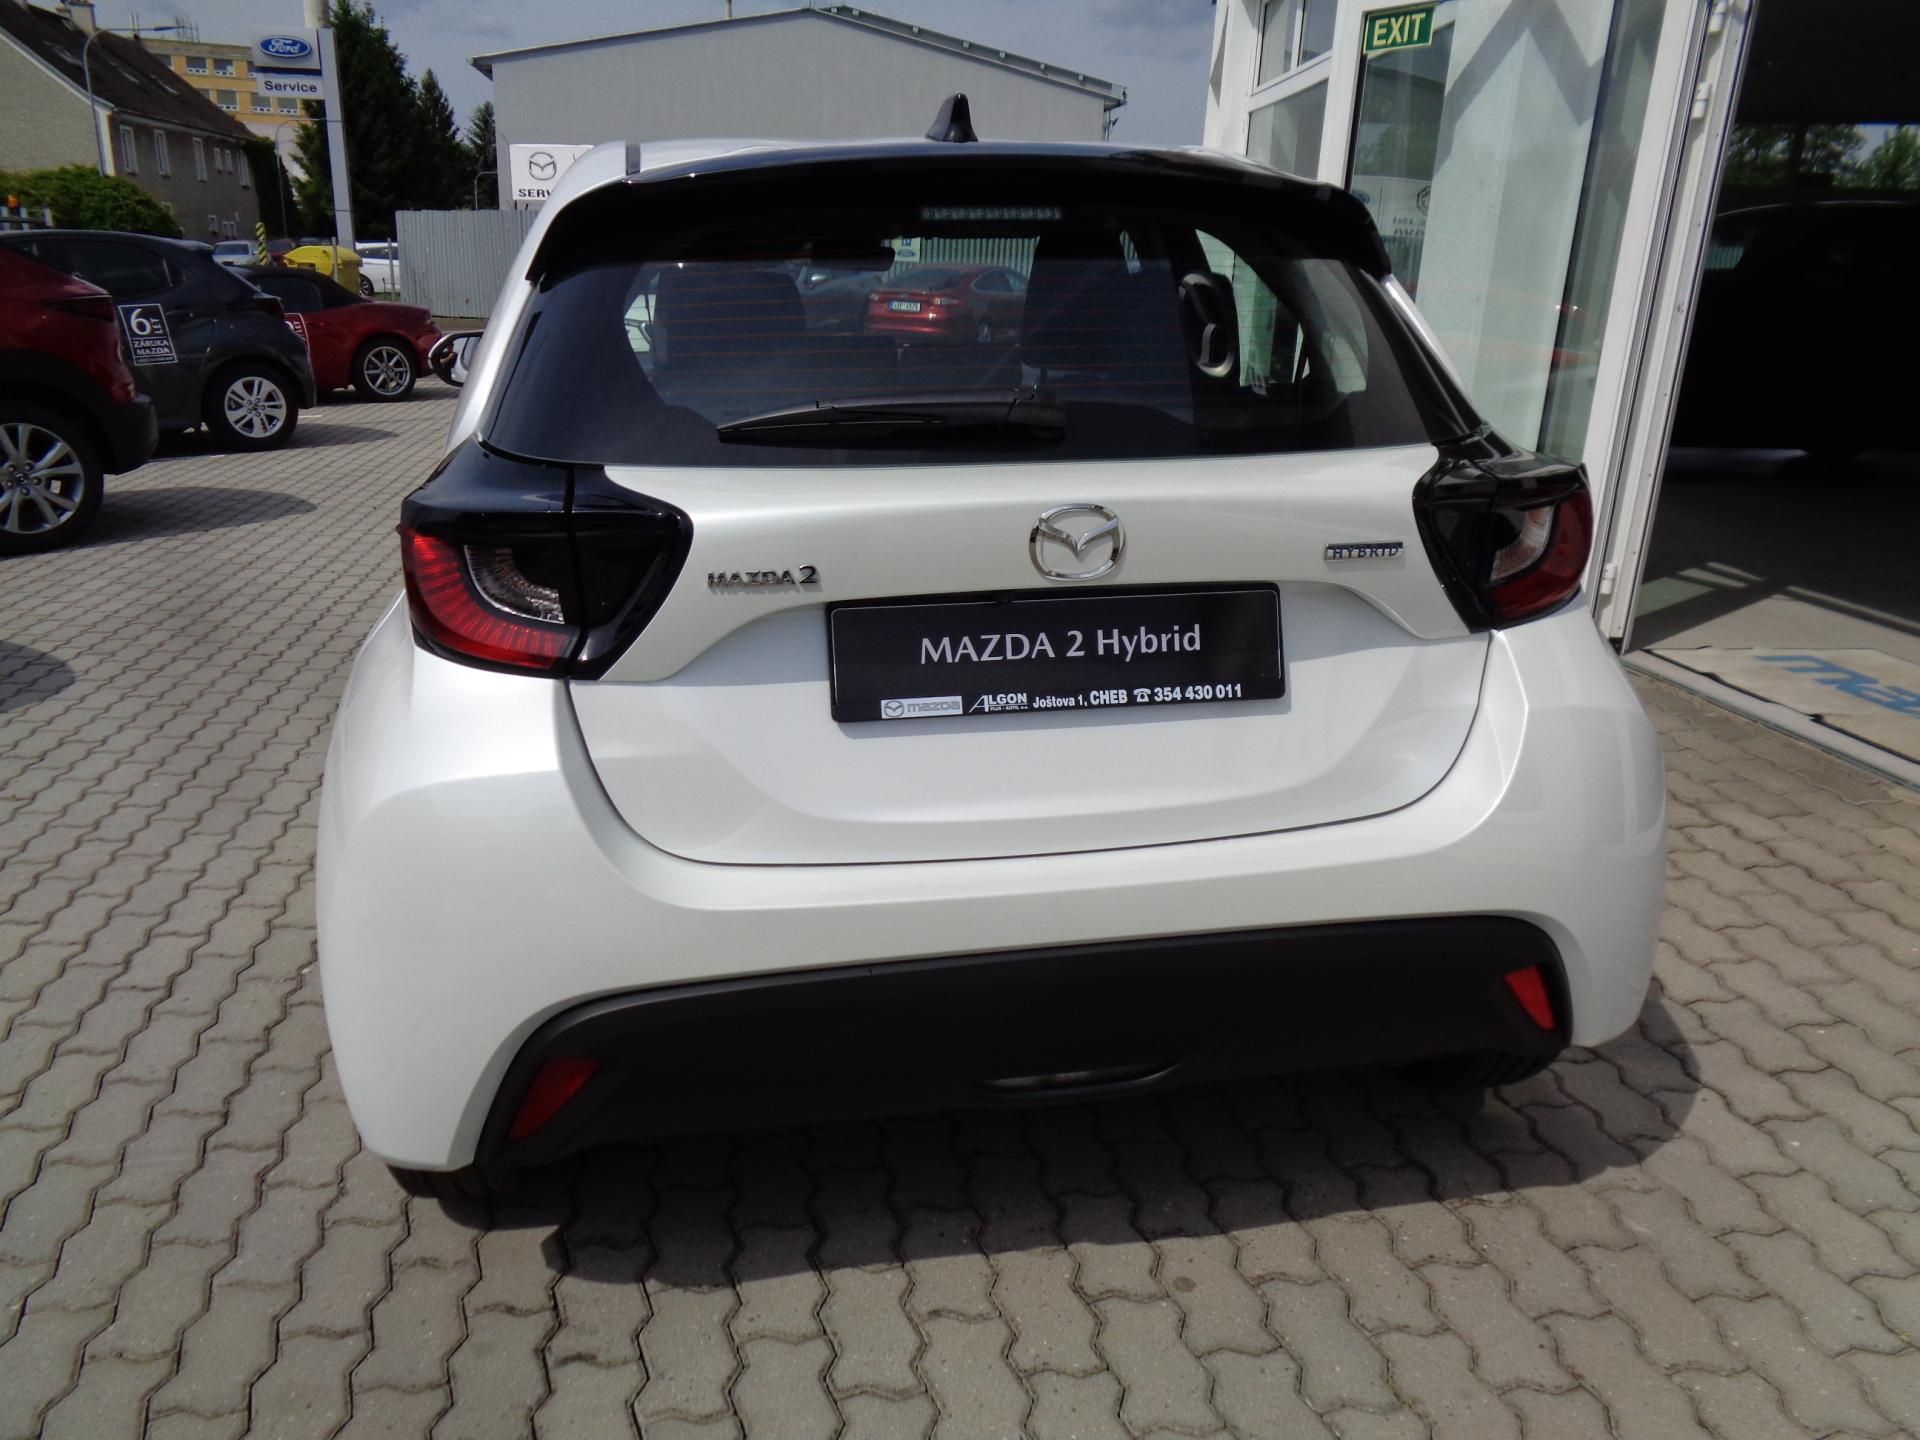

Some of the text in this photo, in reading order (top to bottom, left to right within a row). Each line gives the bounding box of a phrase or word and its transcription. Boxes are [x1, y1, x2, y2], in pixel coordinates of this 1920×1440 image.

[1373, 12, 1426, 47] EXIT
[268, 39, 301, 53] Ford
[264, 80, 318, 93] Service
[130, 308, 152, 335] 6
[1330, 543, 1400, 560] HYBRID
[920, 623, 1201, 664] MAZDA 2 Hybrid
[969, 692, 1028, 713] ALGON
[1032, 683, 1242, 709] Joštova 1, CHEB 354 430 011
